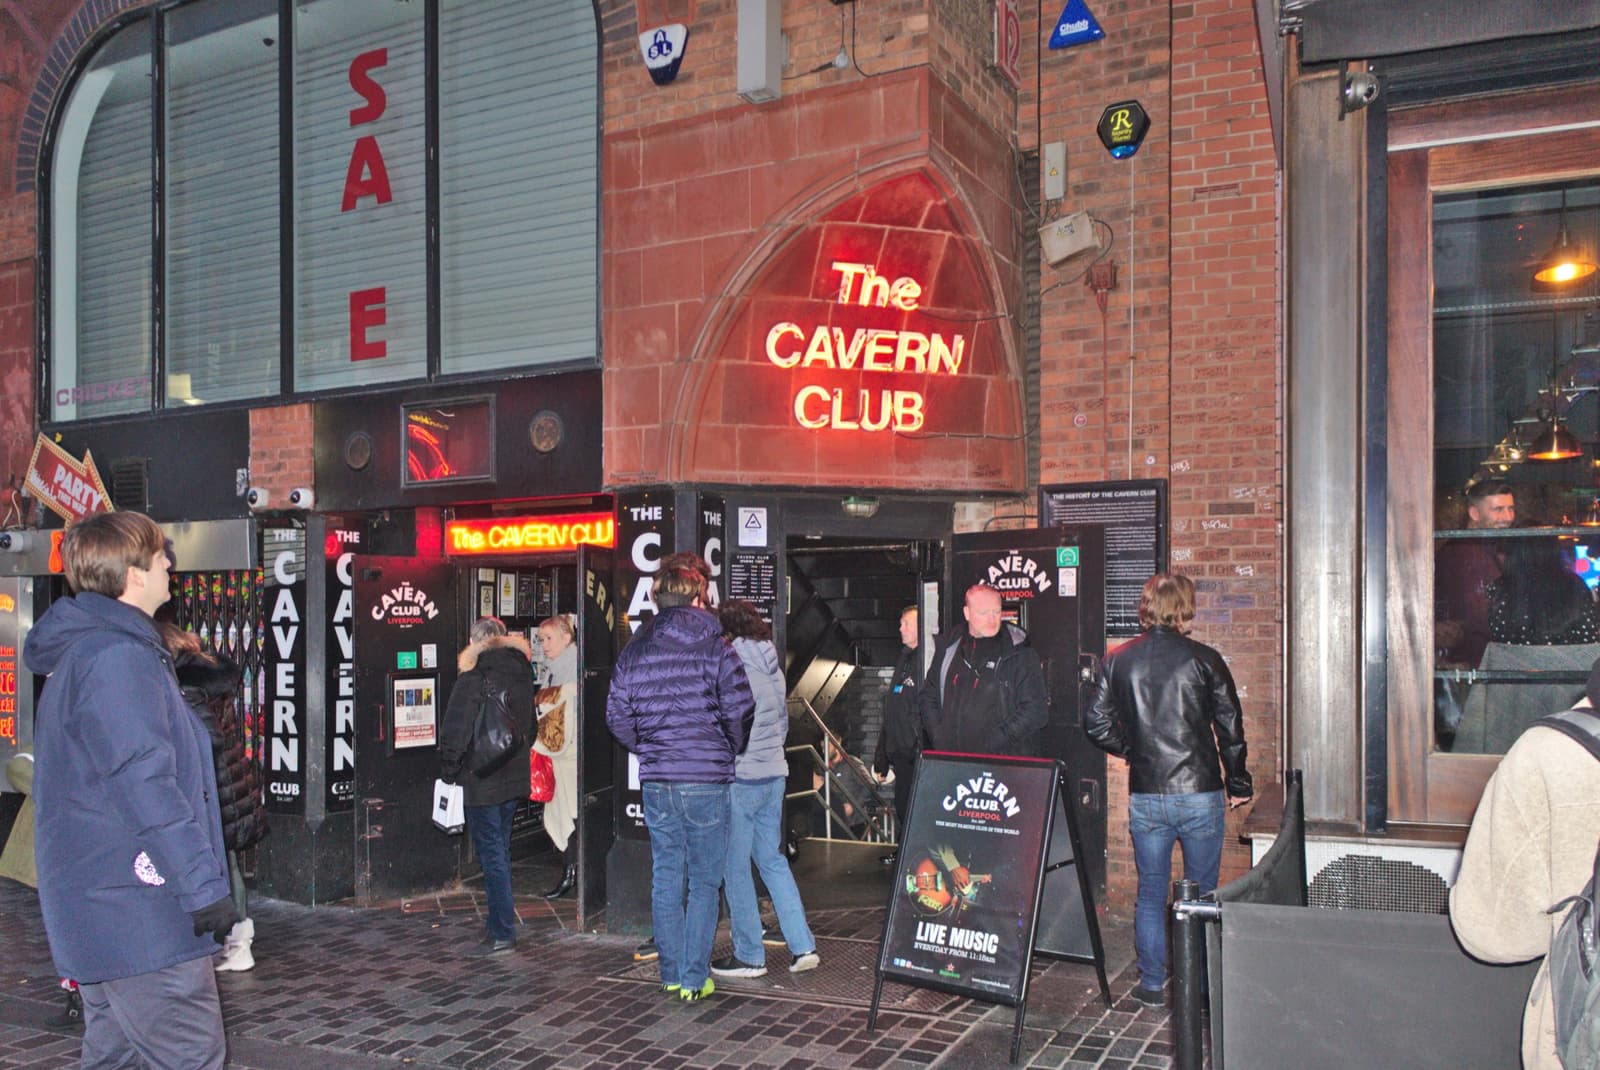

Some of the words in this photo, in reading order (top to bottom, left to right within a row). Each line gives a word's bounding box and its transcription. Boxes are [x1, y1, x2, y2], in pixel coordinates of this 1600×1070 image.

[1059, 19, 1089, 33] Chubb
[831, 261, 922, 311] The
[765, 321, 966, 376] CAVERN
[56, 377, 150, 406] CRICKET
[793, 384, 925, 432] CLUB
[53, 463, 104, 512] PARTY
[631, 506, 663, 521] THE
[704, 511, 722, 526] THE
[273, 529, 297, 541] THE
[335, 530, 360, 543] THE
[451, 527, 485, 549] The
[488, 523, 569, 548] CAVERN
[979, 556, 1051, 592] AVERN
[999, 577, 1030, 589] CLUB
[371, 587, 439, 621] CAVERN
[391, 605, 421, 616] CLUB
[387, 616, 425, 625] LIVERPOOL
[271, 551, 300, 772] CAVERN
[270, 782, 300, 796] CLUB
[943, 777, 1020, 818] CAVERN
[965, 797, 998, 811] CLUB
[626, 803, 645, 818] CL
[958, 809, 1001, 821] LIVERPOOL
[916, 921, 947, 945] LIVE
[949, 927, 999, 954] MUSIC
[913, 941, 948, 955] EVERYDAY
[948, 947, 968, 959] FROM
